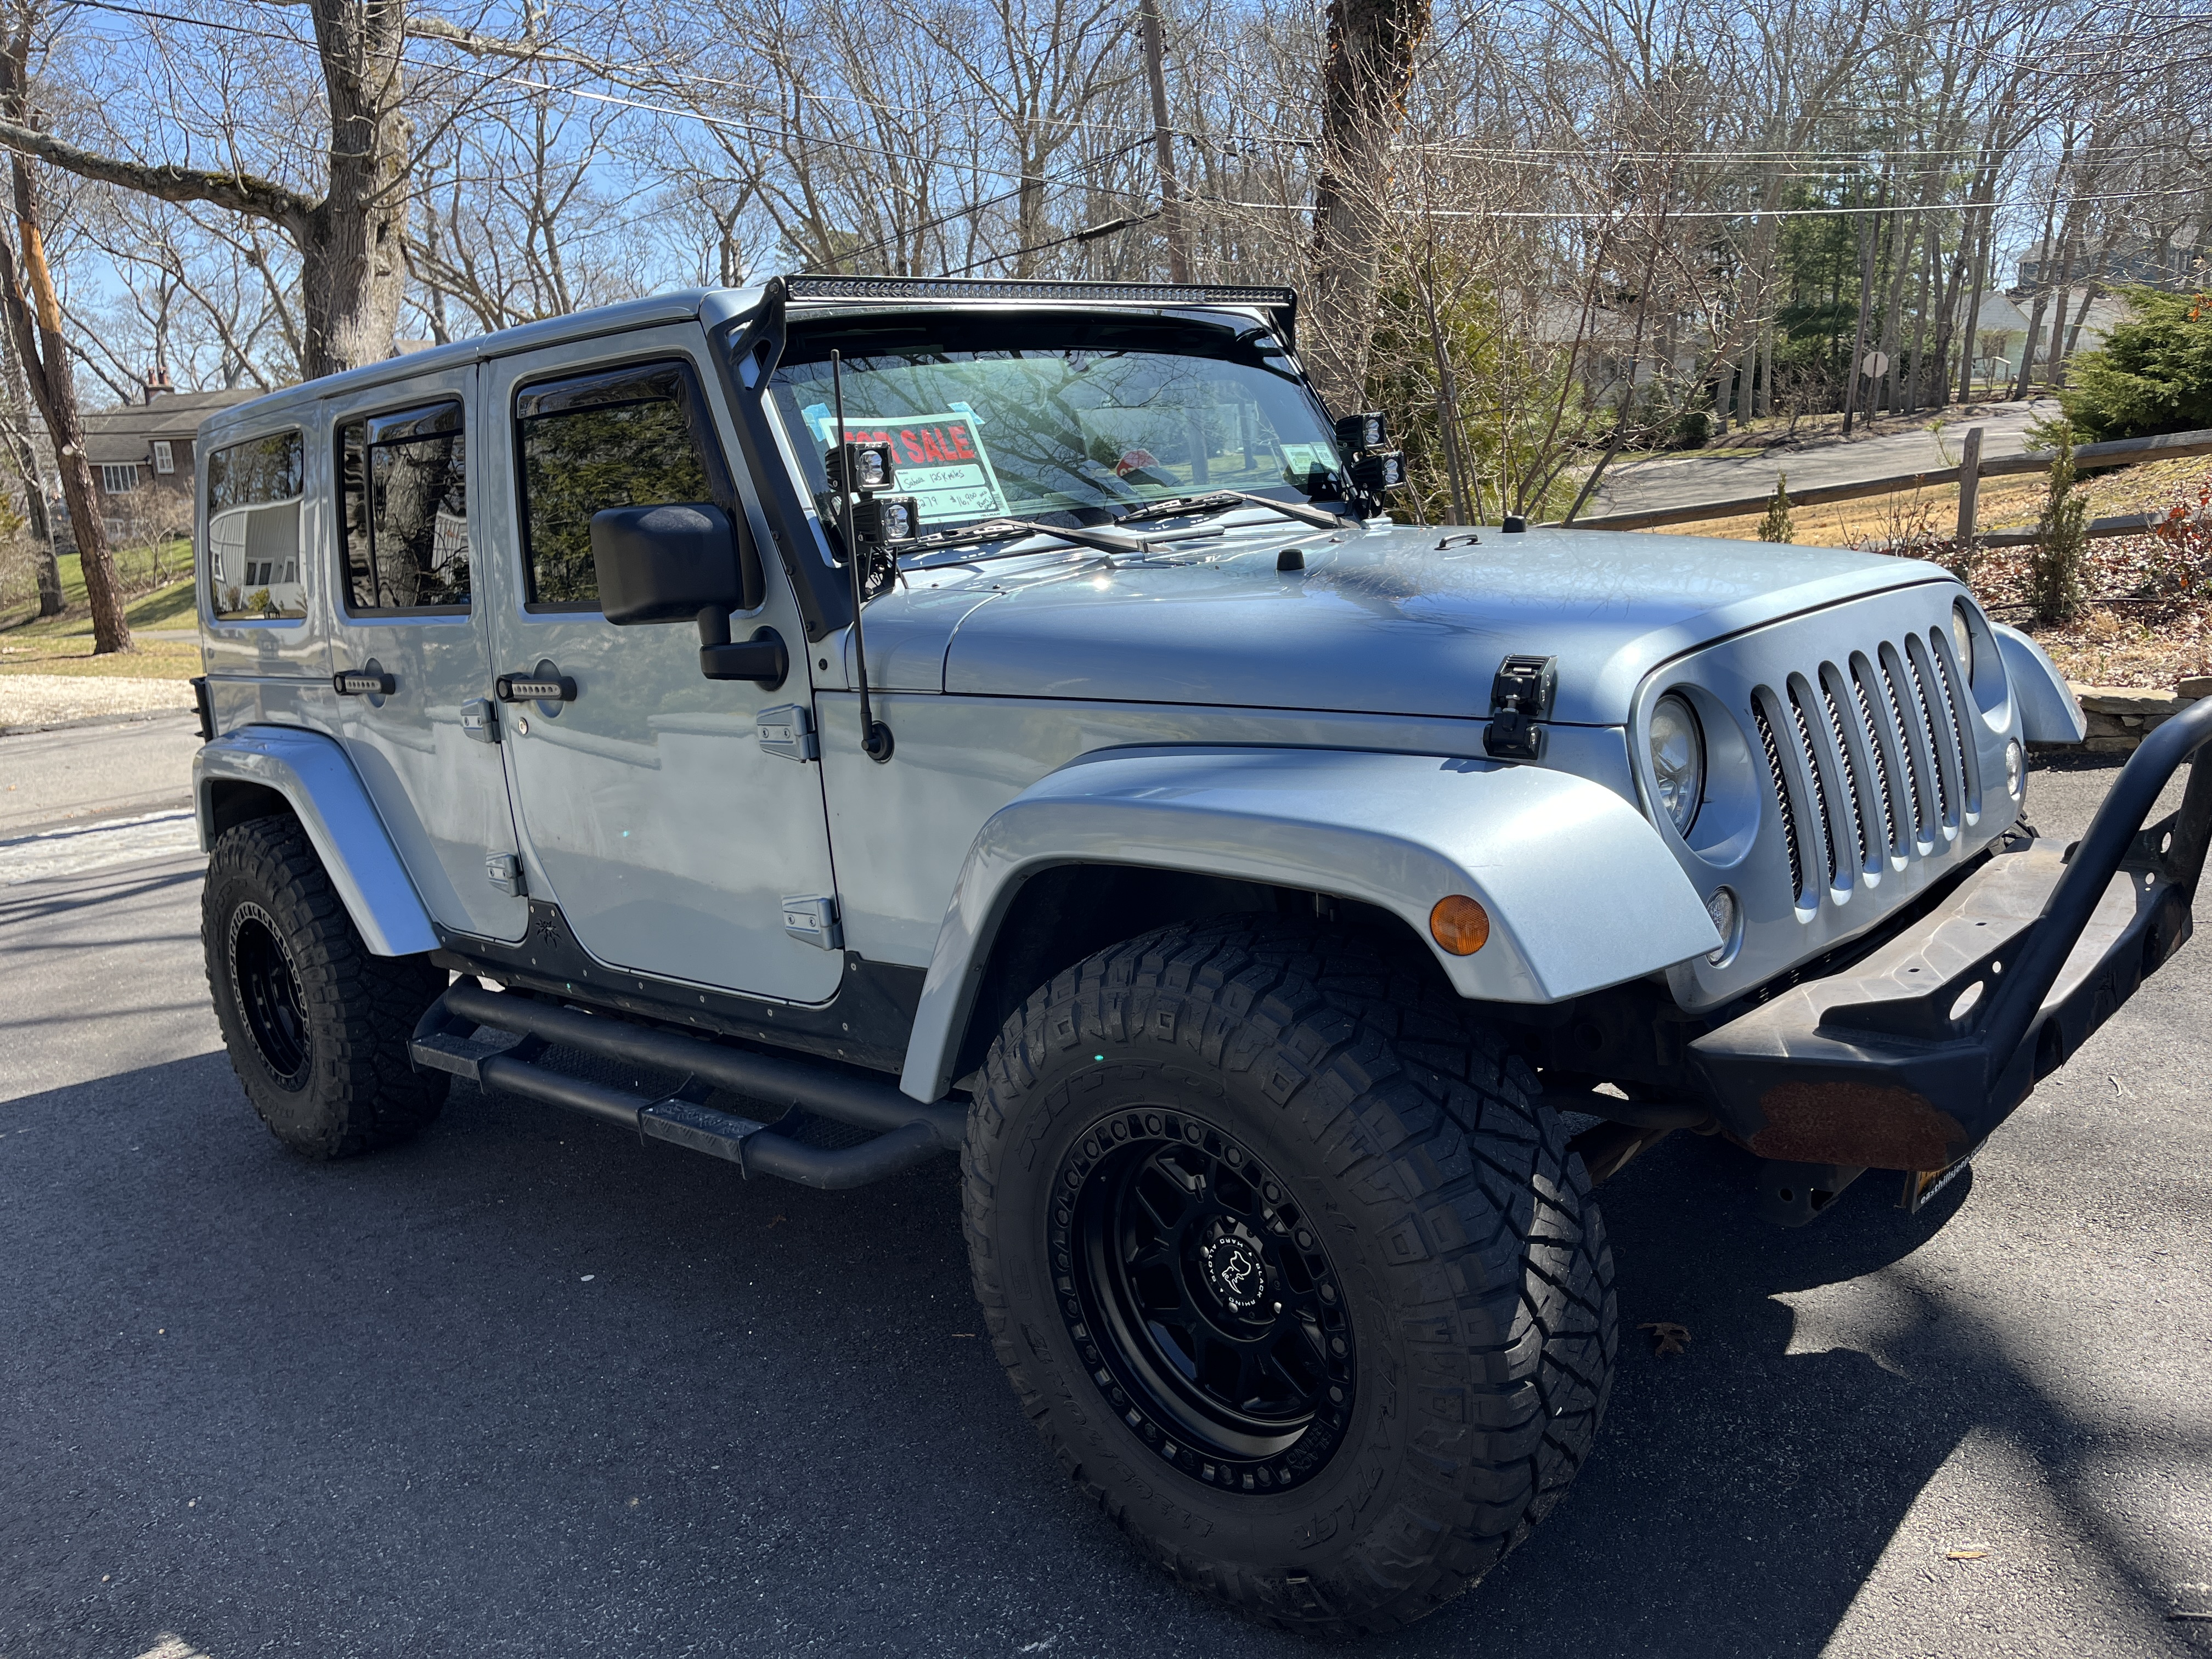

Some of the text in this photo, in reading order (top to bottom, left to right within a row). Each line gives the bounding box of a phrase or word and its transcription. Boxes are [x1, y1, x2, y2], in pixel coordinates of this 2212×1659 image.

[900, 426, 975, 464] SALE
[1920, 1139, 1986, 1205] easthillsjeep.com
[1208, 1238, 1243, 1282] HARD ALLOYS
[1229, 1263, 1264, 1307] BLACK RHINO
[1286, 1422, 1324, 1465] RHINO
[1291, 1431, 1333, 1476] BLACK
